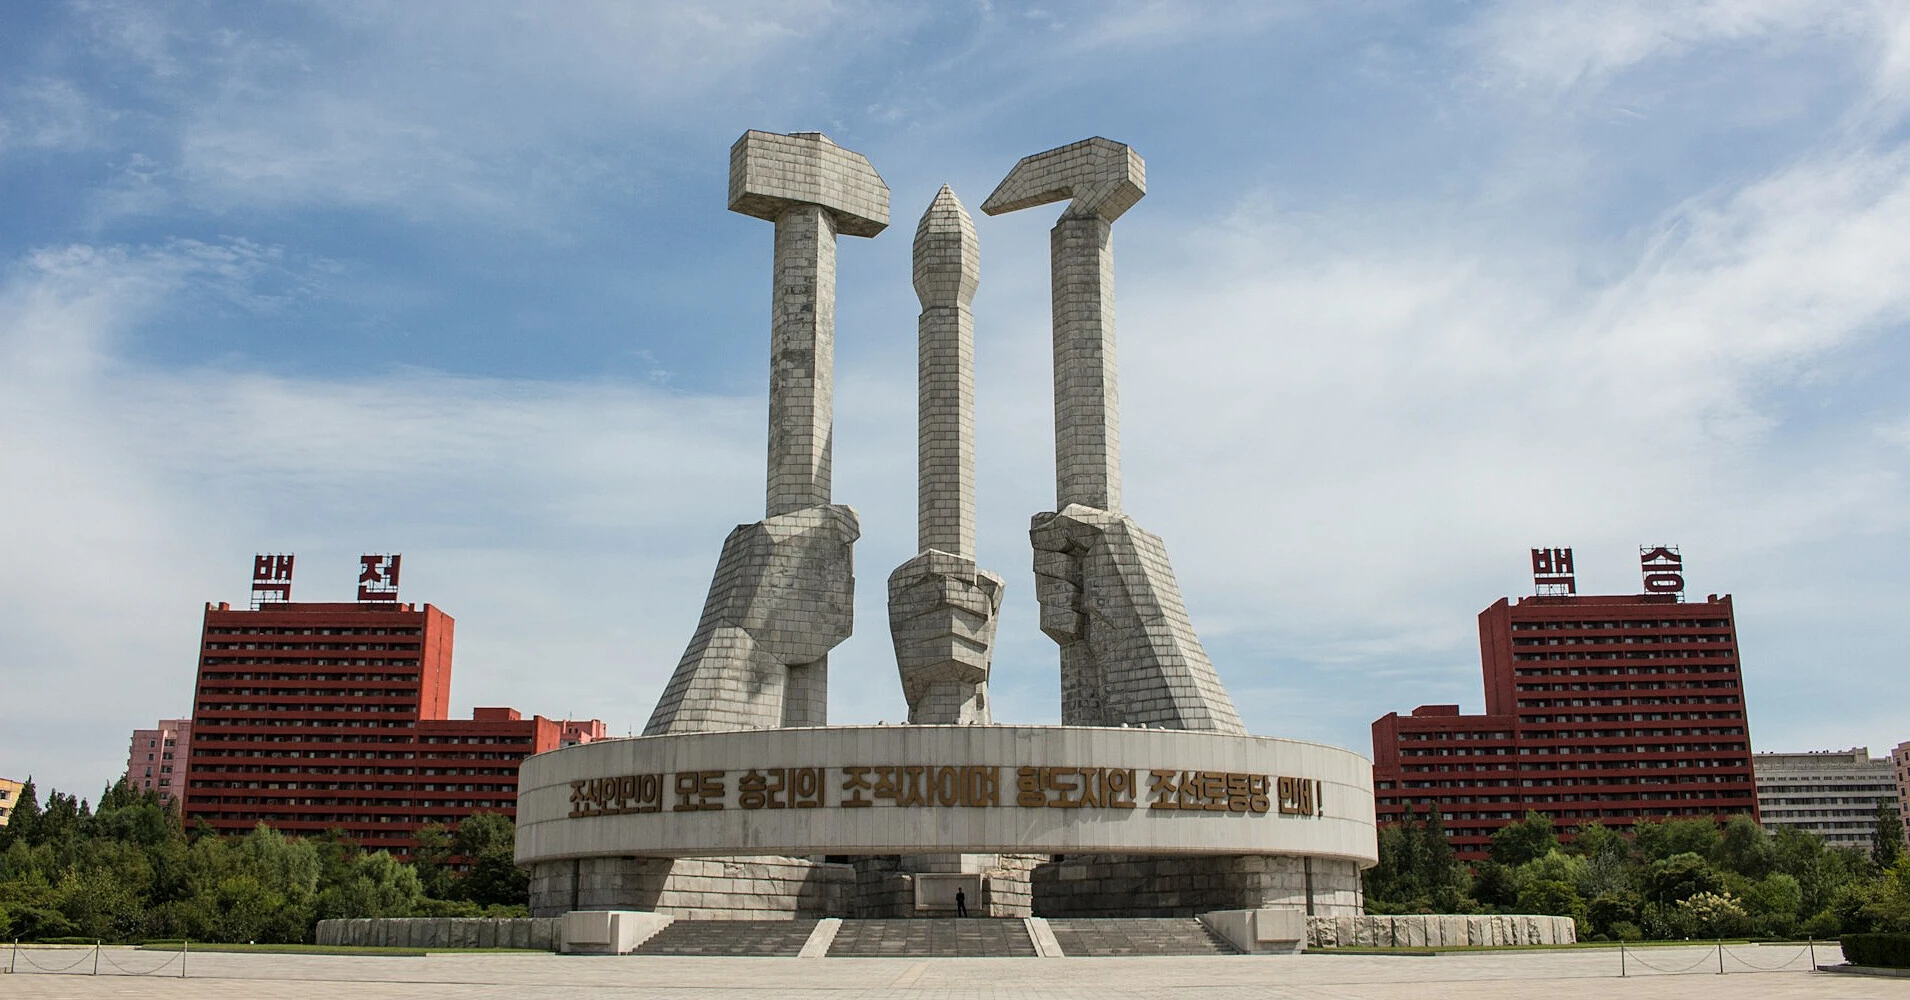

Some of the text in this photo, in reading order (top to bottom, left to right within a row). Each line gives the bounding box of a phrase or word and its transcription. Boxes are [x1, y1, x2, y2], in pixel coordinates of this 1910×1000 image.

[252, 554, 401, 601] 백 전
[1531, 547, 1685, 594] 백 승
[568, 773, 664, 818] 조선인민의
[672, 770, 726, 812] 모든
[738, 767, 825, 810] 승리의
[841, 765, 1000, 808] 조직자이며
[1016, 765, 1137, 810] 향도자인
[1150, 769, 1271, 814] 조선로동당
